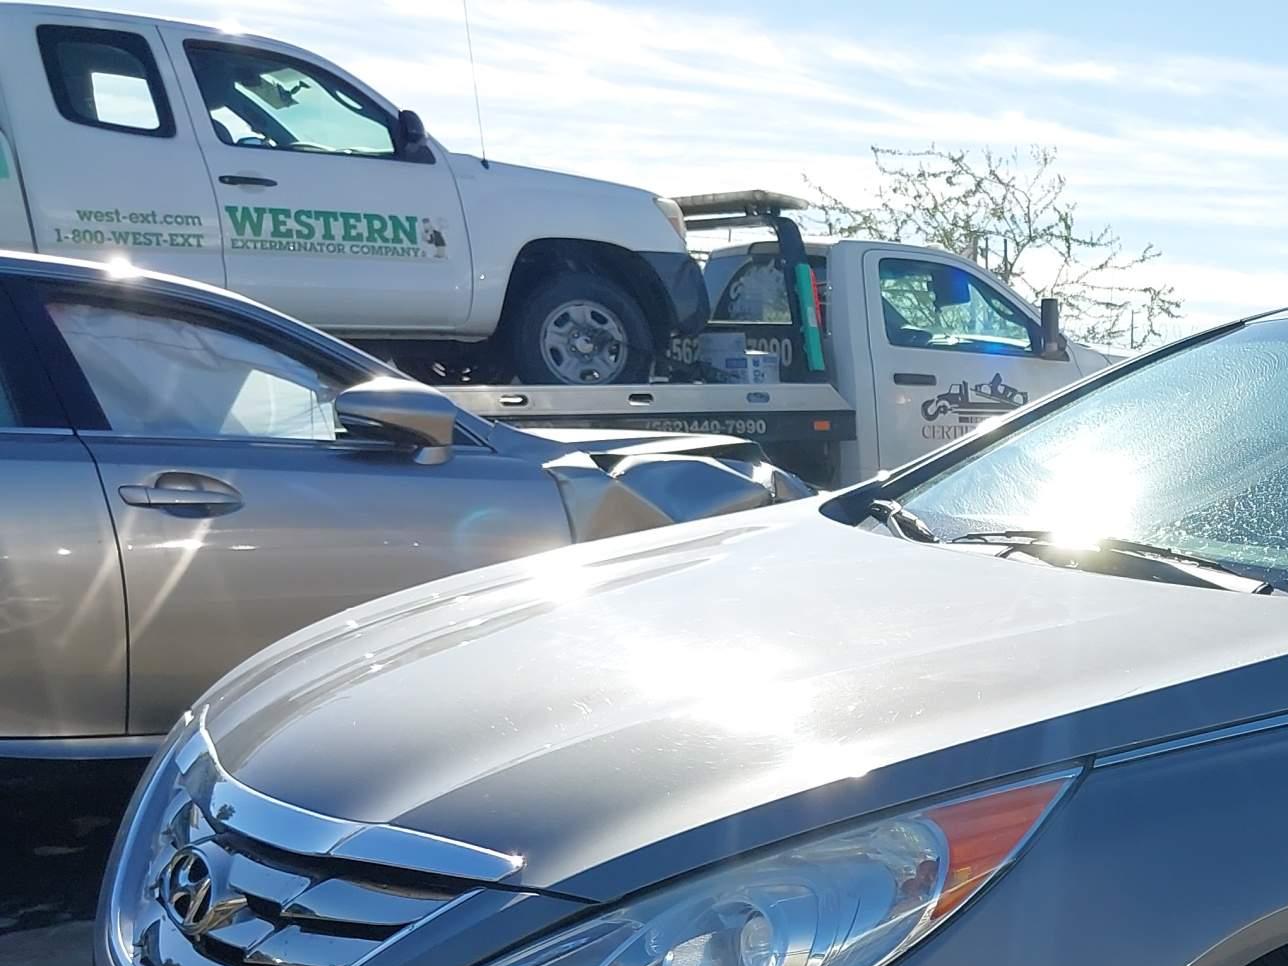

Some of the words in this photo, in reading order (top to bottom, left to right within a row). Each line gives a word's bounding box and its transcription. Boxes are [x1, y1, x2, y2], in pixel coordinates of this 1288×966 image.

[76, 209, 203, 226] west-ext.com
[224, 205, 418, 245] WESTERN
[54, 228, 204, 248] 1-800-WEST-EXT
[231, 238, 345, 254] EXTERMINATOR
[350, 244, 420, 257] COMPANY
